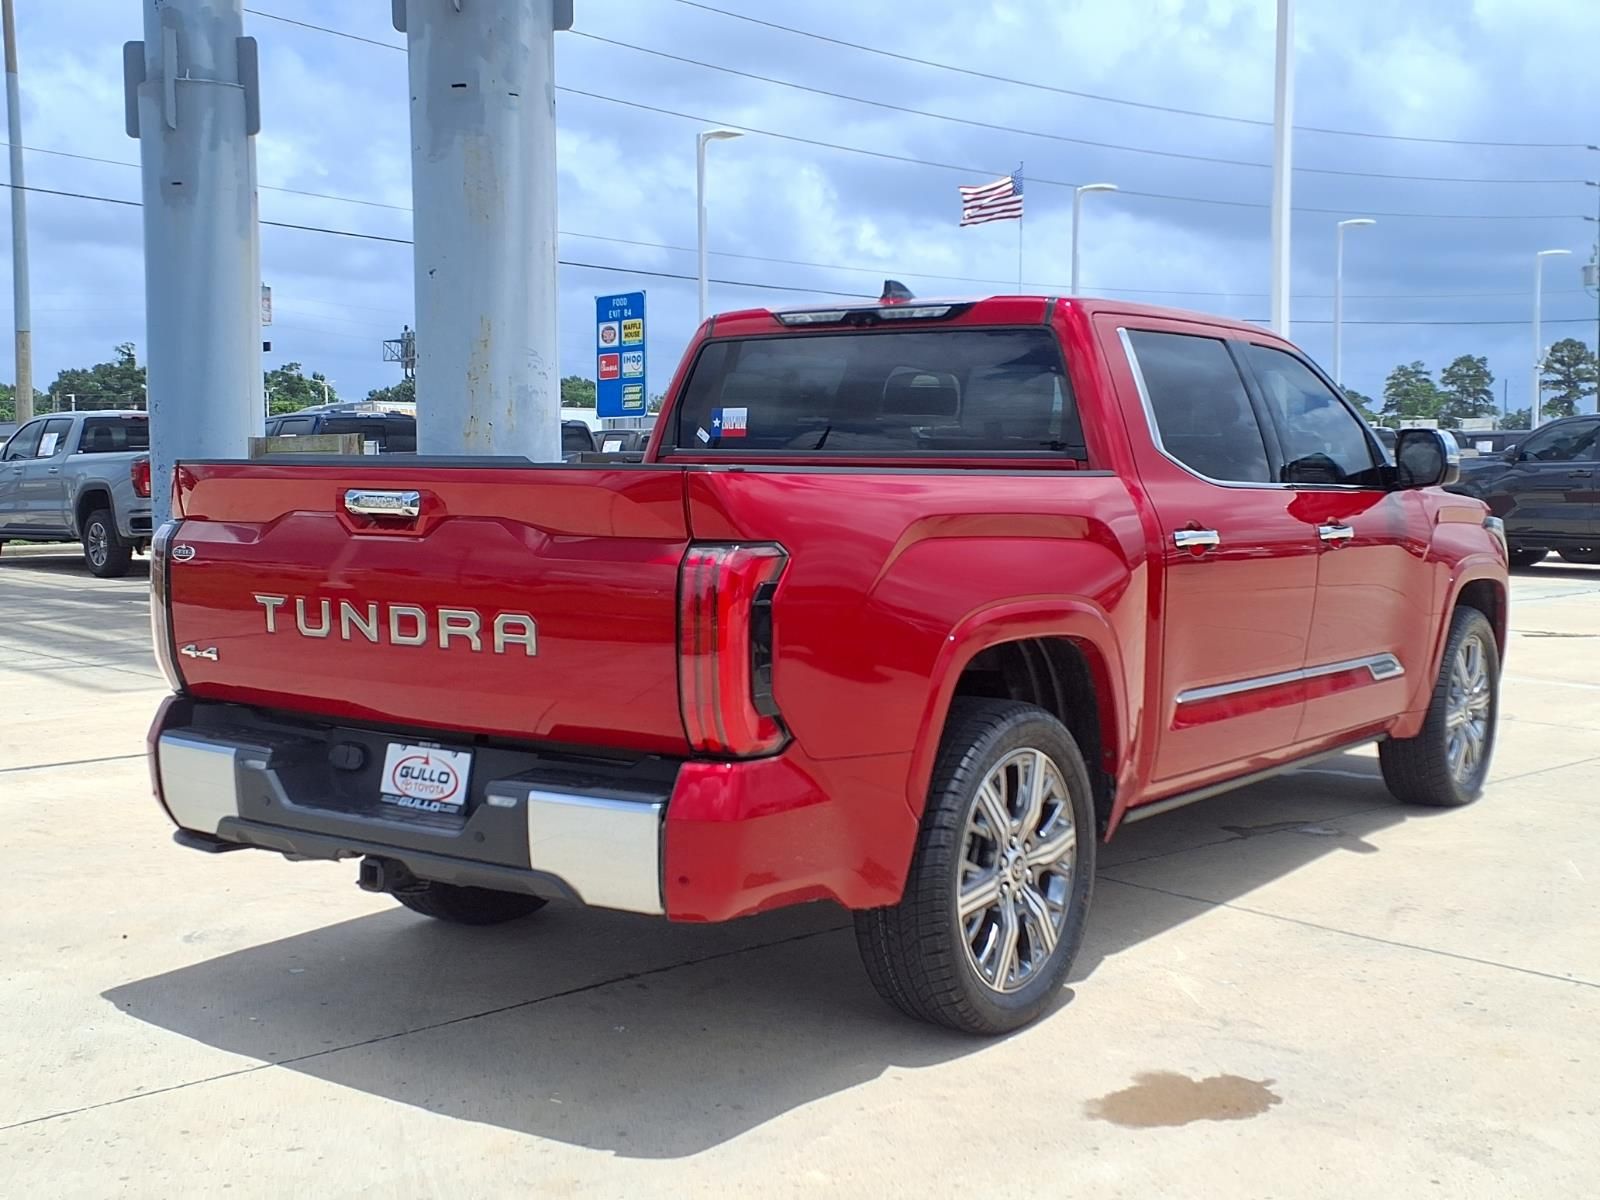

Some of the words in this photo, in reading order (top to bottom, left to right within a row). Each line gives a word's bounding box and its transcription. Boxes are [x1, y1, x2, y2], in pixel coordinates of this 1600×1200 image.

[612, 297, 627, 306] FOOD
[608, 309, 621, 319] EXIT
[623, 322, 641, 331] WAFFLE
[624, 330, 640, 339] HOUSE
[254, 594, 538, 657] TUNDRA
[400, 766, 450, 784] GULLO
[414, 783, 444, 794] TOYOTA
[398, 797, 440, 812] GULLO
